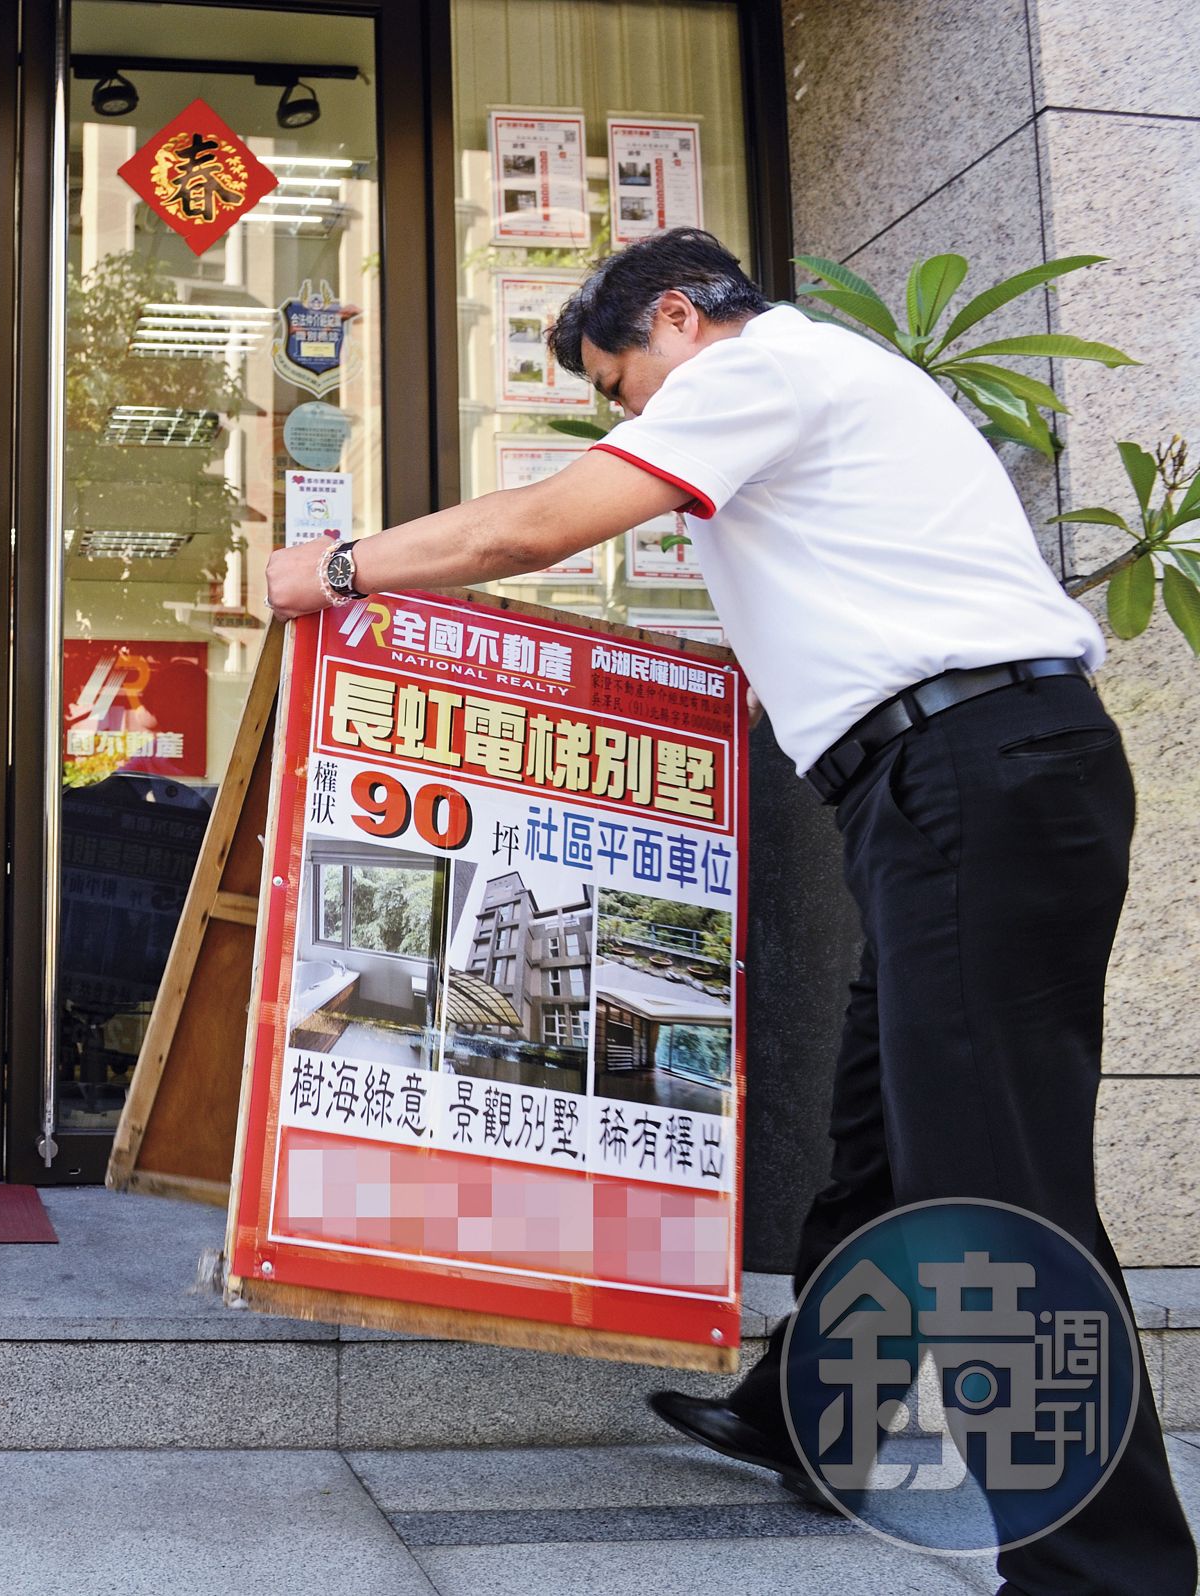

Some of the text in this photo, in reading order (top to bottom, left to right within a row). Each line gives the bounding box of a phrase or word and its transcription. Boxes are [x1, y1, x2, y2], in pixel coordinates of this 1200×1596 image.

[160, 133, 245, 223] 春
[390, 609, 573, 683] 全國不動產
[391, 651, 570, 697] NATIONAL REALTY
[591, 645, 726, 699] 內湖民權加盟店
[329, 671, 715, 820] 長虹電梯別墅
[310, 760, 732, 896] 權狀 90 坪 社區平面車位
